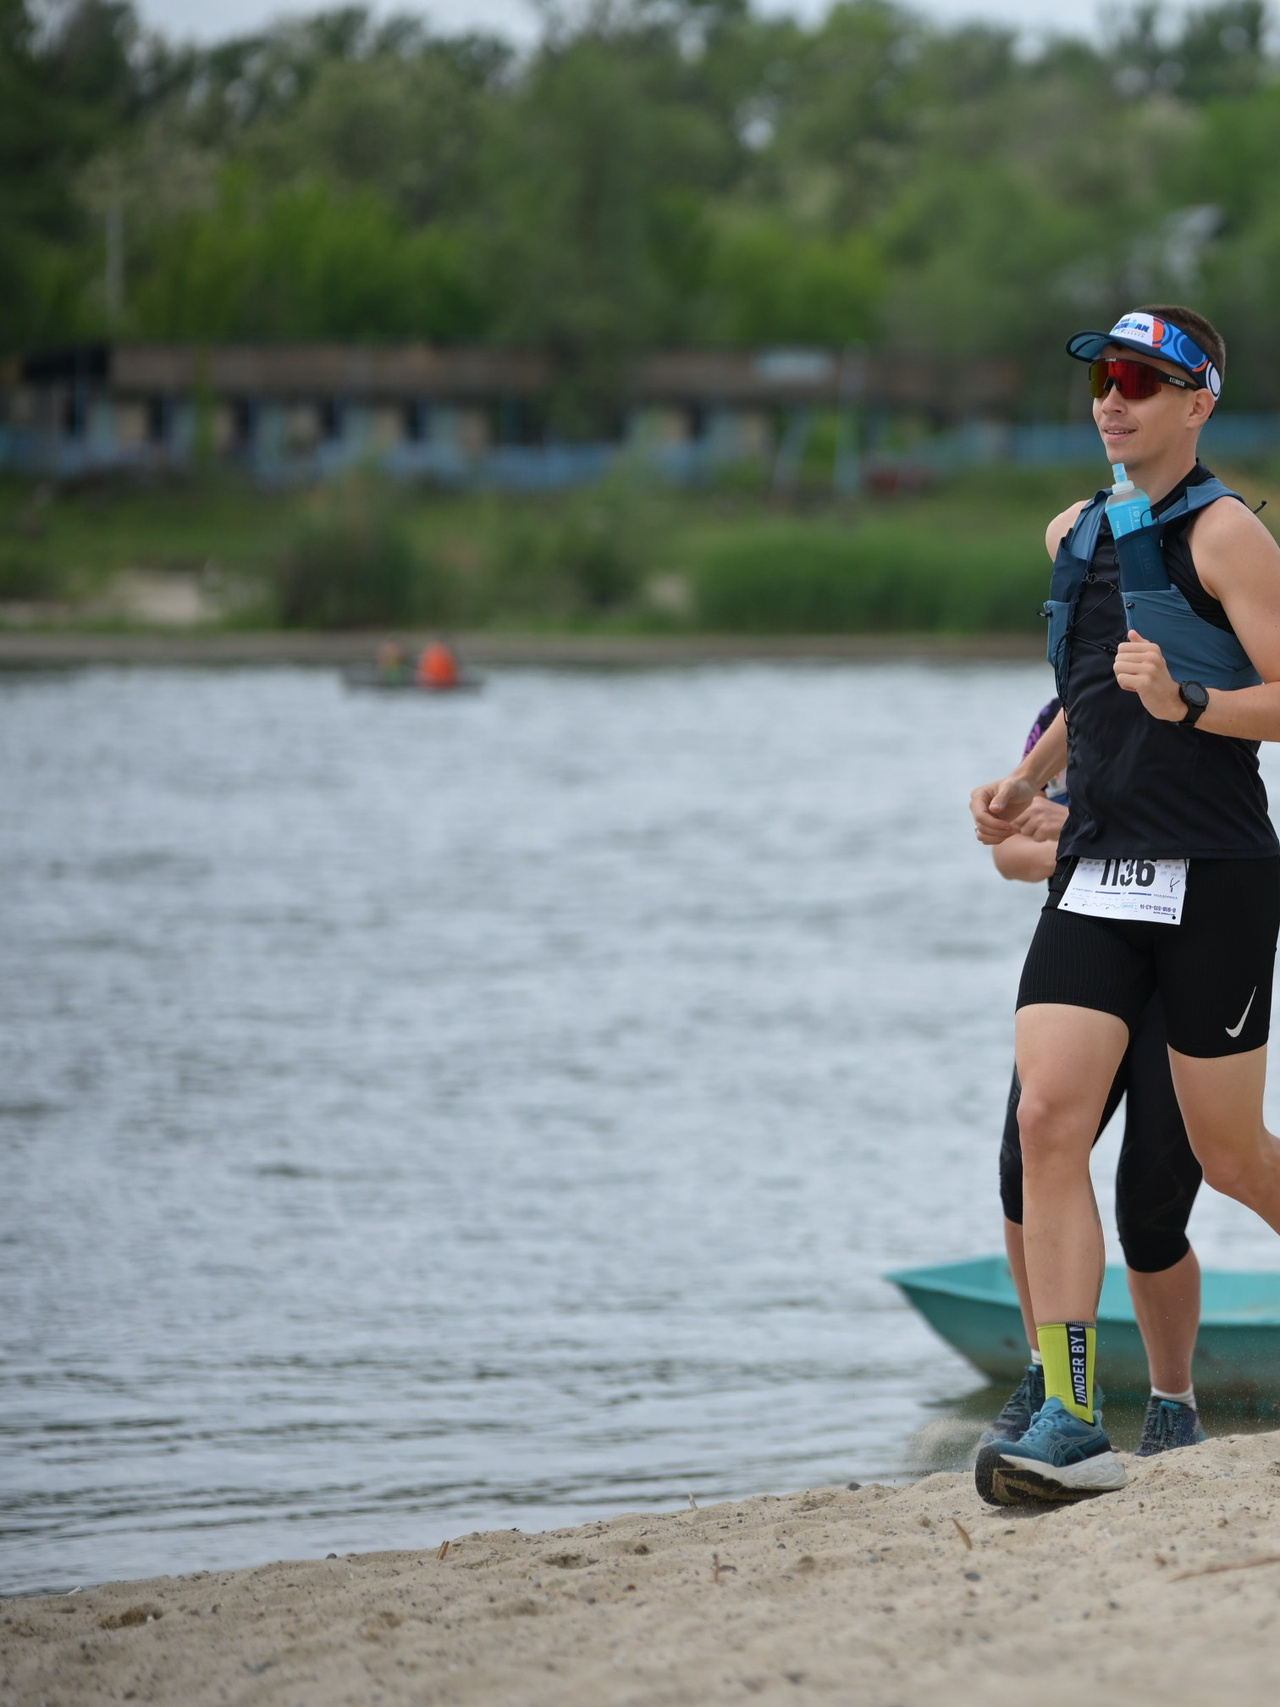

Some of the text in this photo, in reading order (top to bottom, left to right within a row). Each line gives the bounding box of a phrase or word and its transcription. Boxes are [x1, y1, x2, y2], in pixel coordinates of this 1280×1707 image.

[1101, 859, 1155, 887] 1136
[1070, 1336, 1085, 1353] BY
[1072, 1358, 1086, 1403] UNDER
